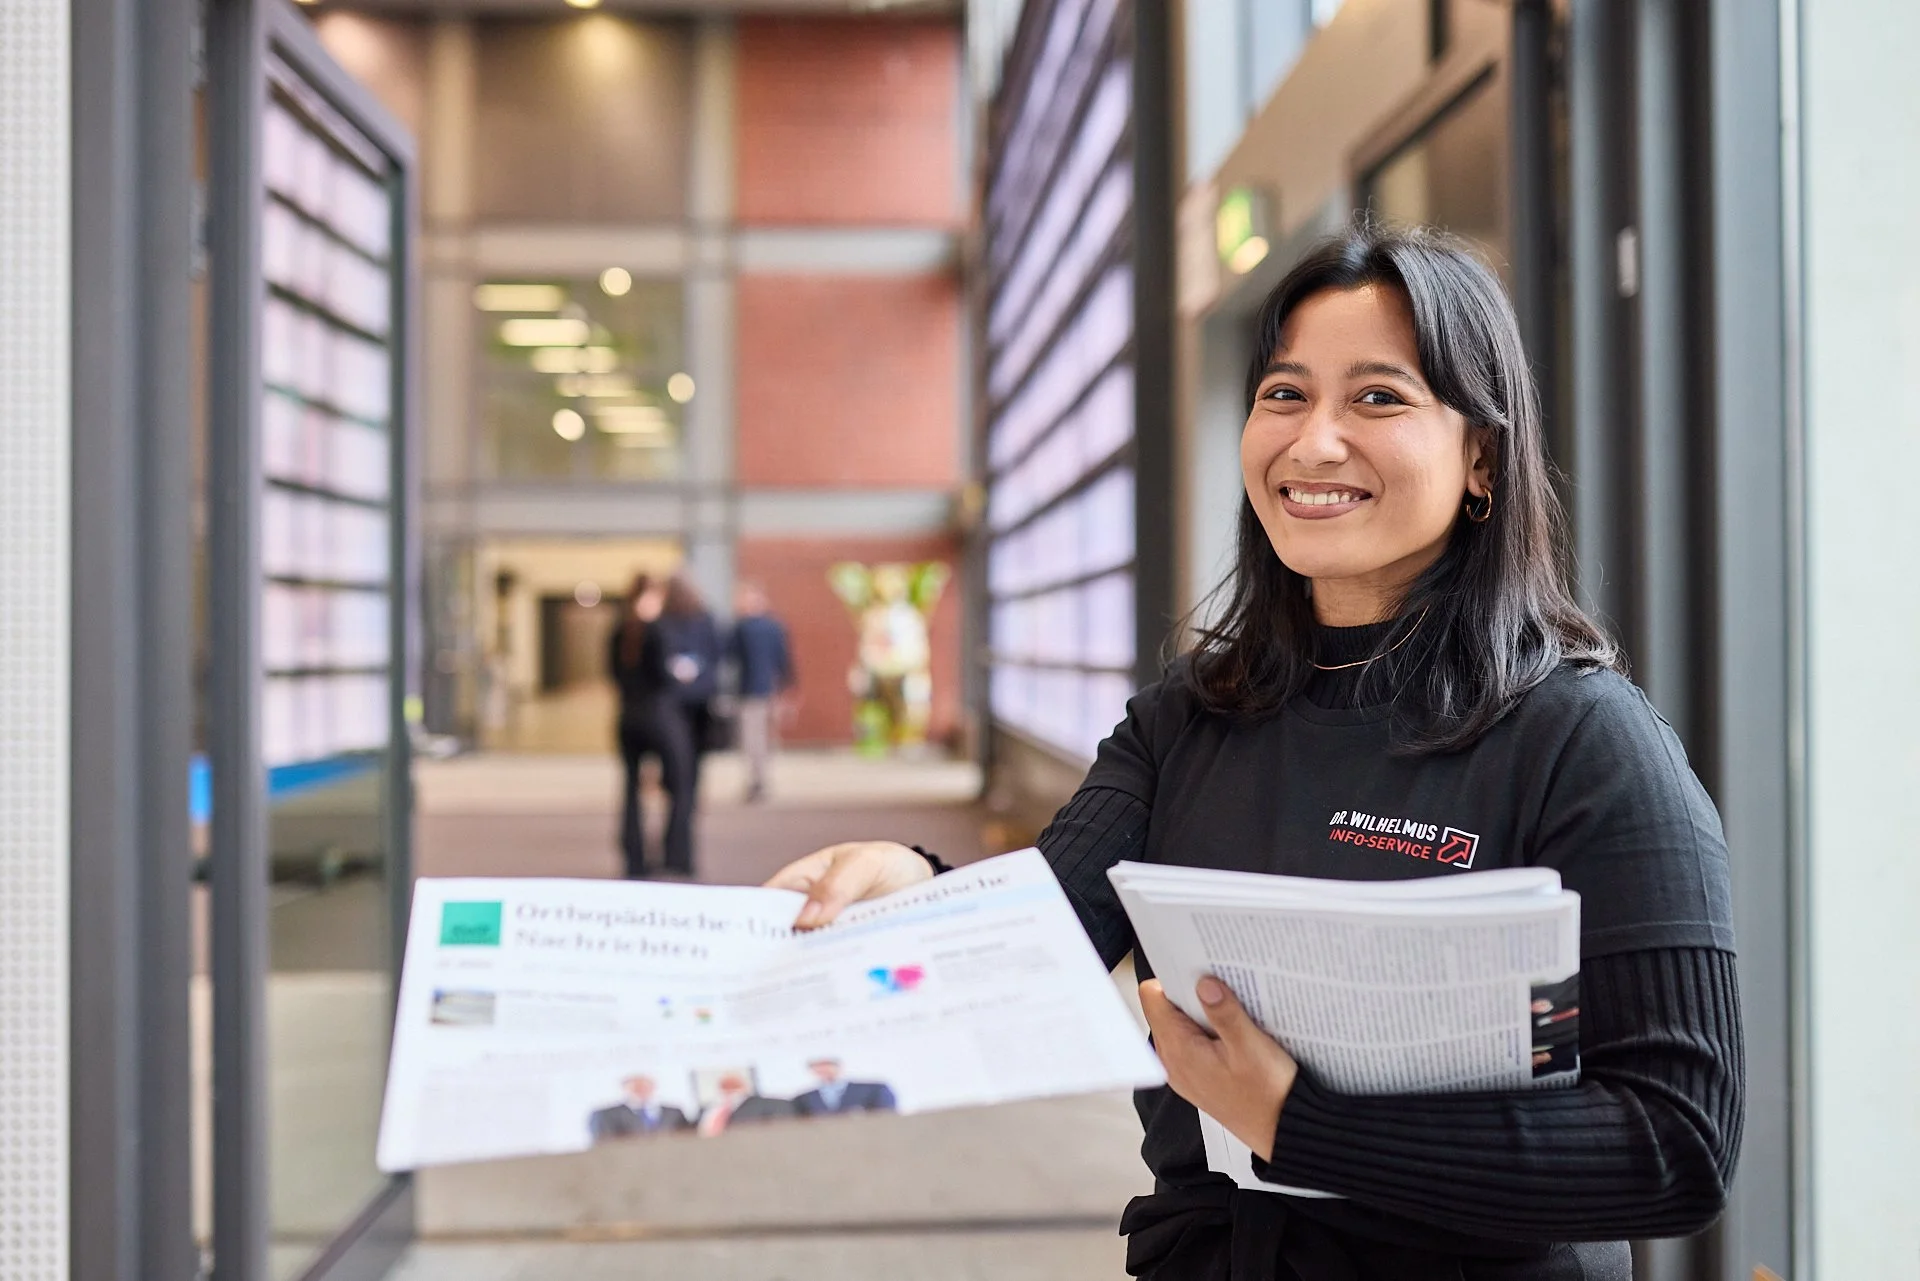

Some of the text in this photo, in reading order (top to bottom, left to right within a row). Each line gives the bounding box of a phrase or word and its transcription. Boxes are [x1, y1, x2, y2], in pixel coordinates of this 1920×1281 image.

[1329, 810, 1438, 842] DR. WILHELMUS
[1329, 828, 1433, 860] INFO-SERVICE
